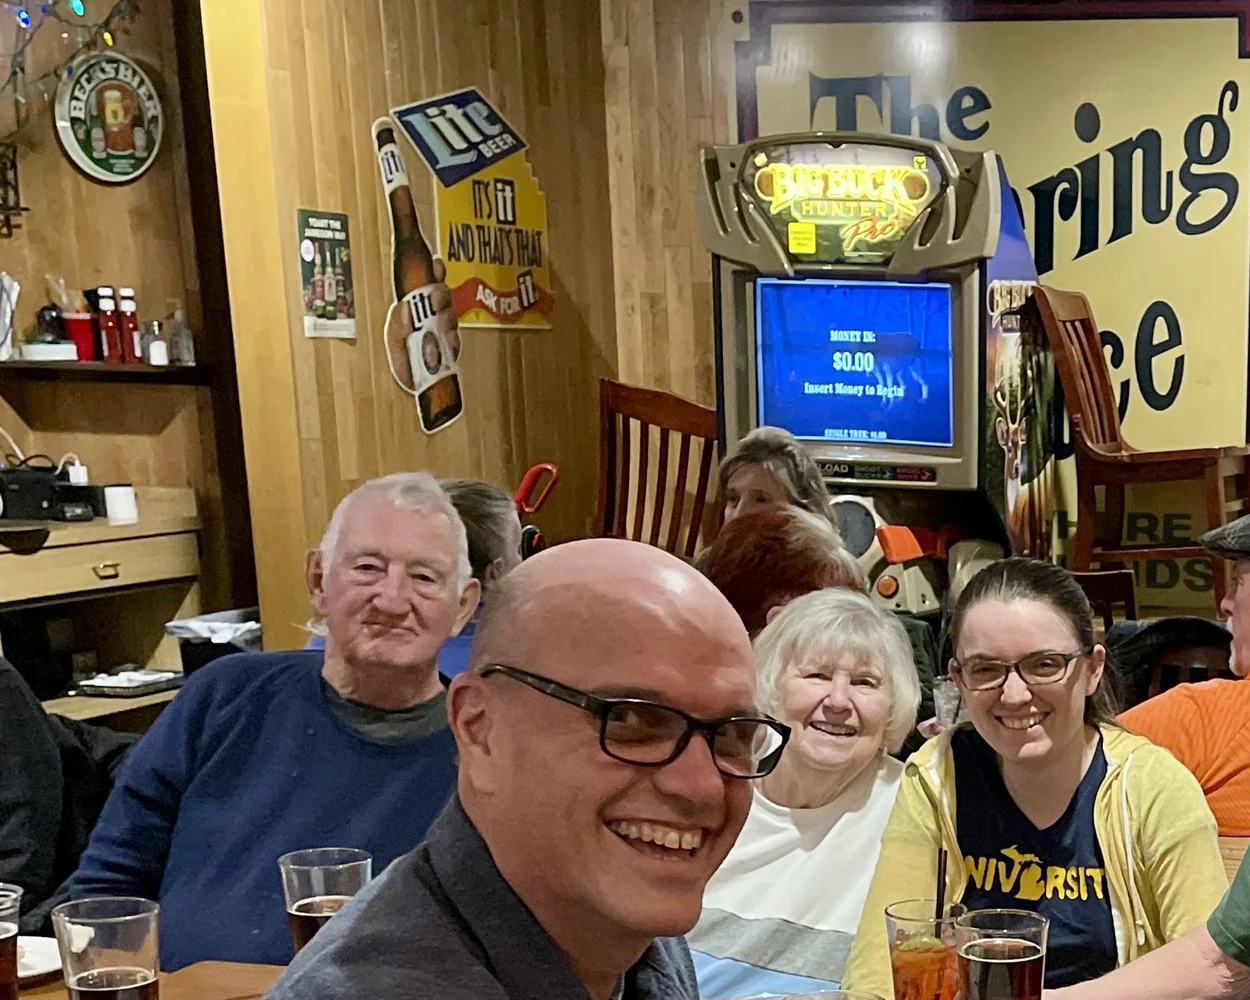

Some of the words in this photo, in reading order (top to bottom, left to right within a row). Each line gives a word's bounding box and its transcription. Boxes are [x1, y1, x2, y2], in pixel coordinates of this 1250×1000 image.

[401, 101, 502, 169] Lite
[478, 133, 517, 158] BEER
[771, 165, 824, 204] BIG
[825, 166, 914, 206] BUCK
[1017, 80, 1239, 275] ring
[472, 179, 493, 219] IT'S
[802, 203, 888, 217] HUNTER
[447, 223, 476, 263] AND
[475, 225, 515, 266] THAT'S
[514, 228, 544, 268] THAT
[844, 218, 897, 250] Pro
[476, 285, 498, 313] ASK
[830, 330, 862, 342] MONEY
[832, 351, 874, 371] $0.00
[804, 382, 833, 394] Insert
[834, 383, 863, 397] Money
[865, 384, 876, 395] to
[877, 385, 904, 398] Begin
